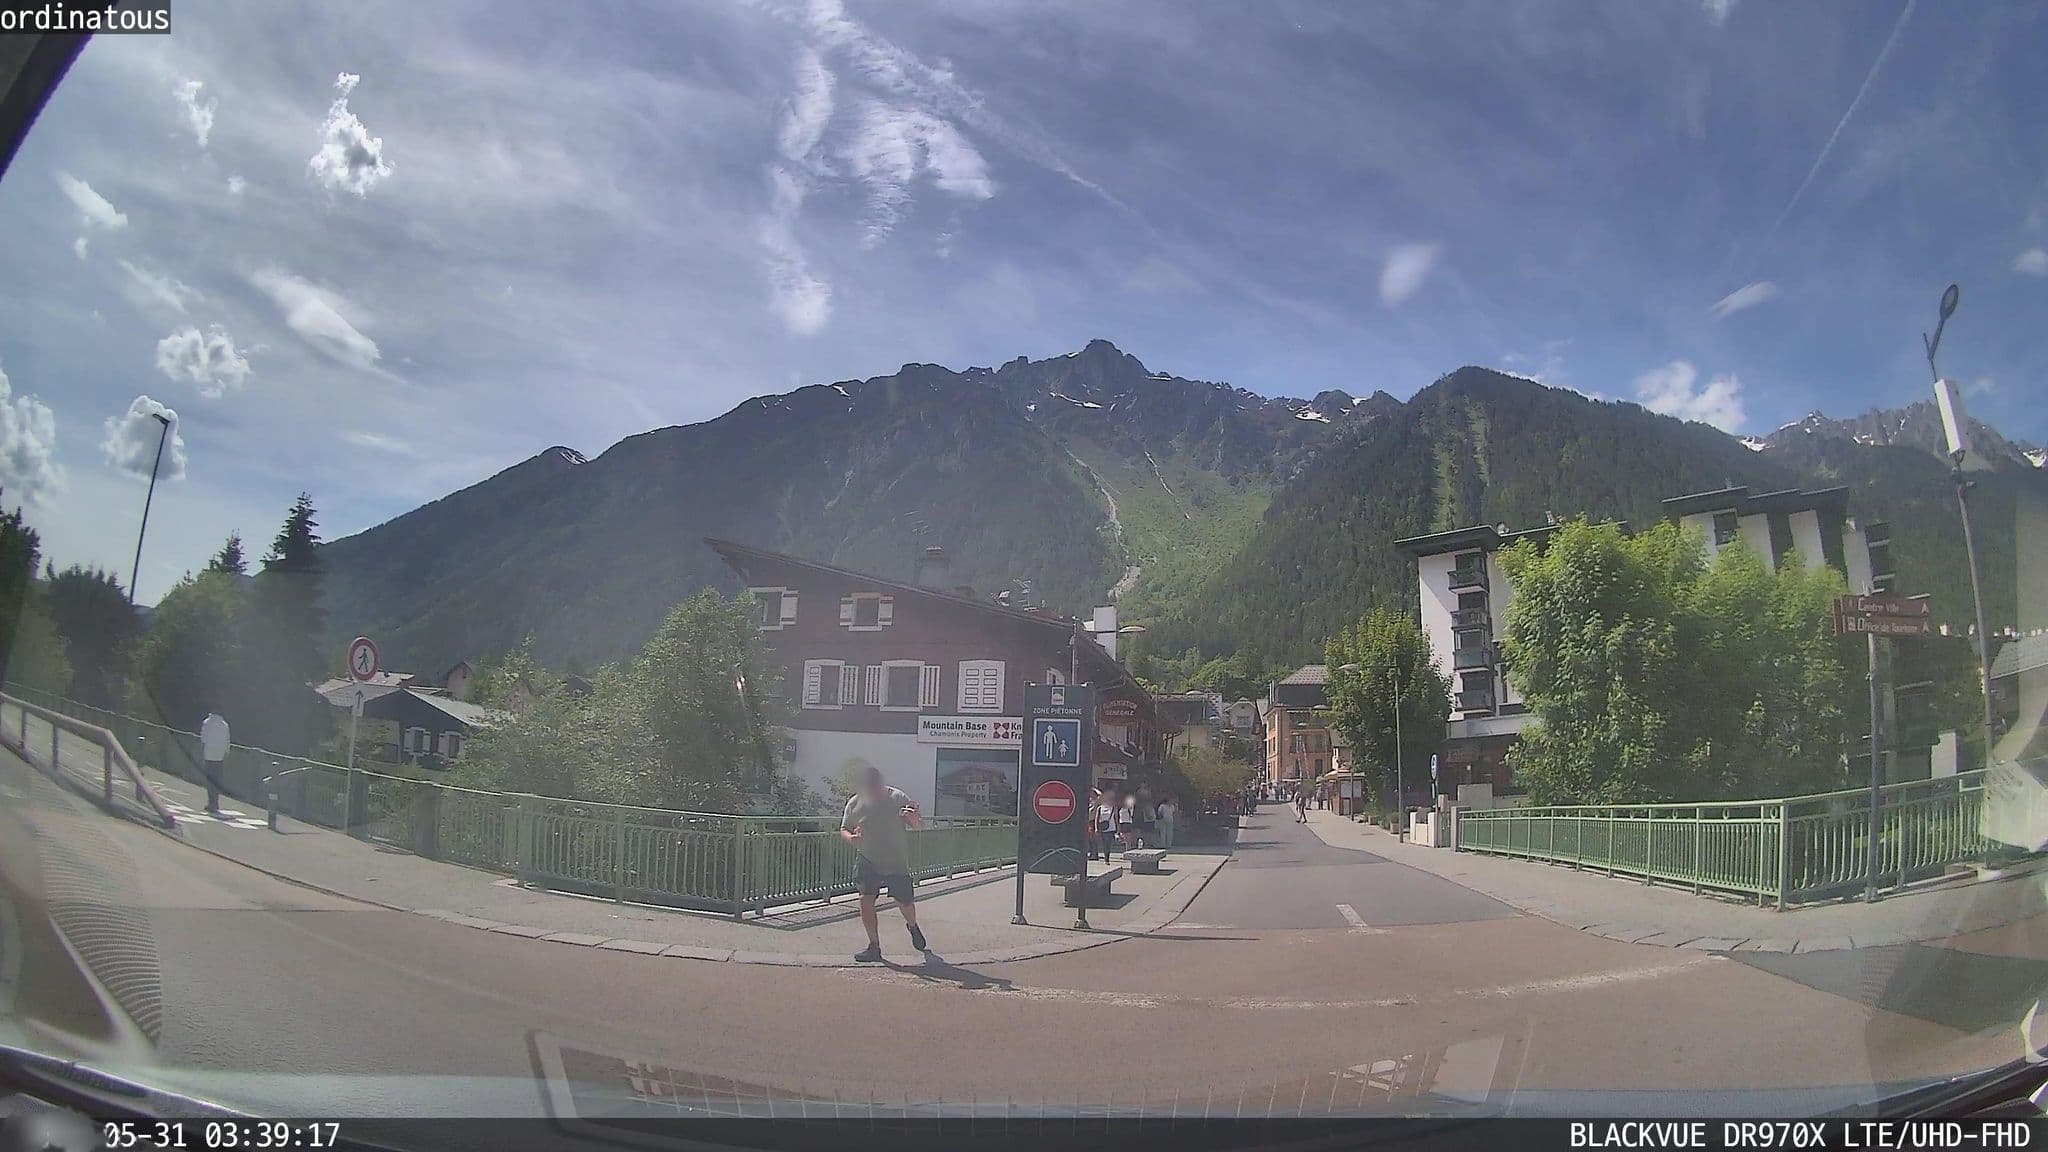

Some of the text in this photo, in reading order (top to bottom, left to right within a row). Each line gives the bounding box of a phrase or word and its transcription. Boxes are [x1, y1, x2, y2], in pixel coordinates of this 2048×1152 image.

[922, 720, 1022, 731] Mountain Base Kn
[961, 731, 987, 739] Property
[1011, 732, 1022, 740] Fra
